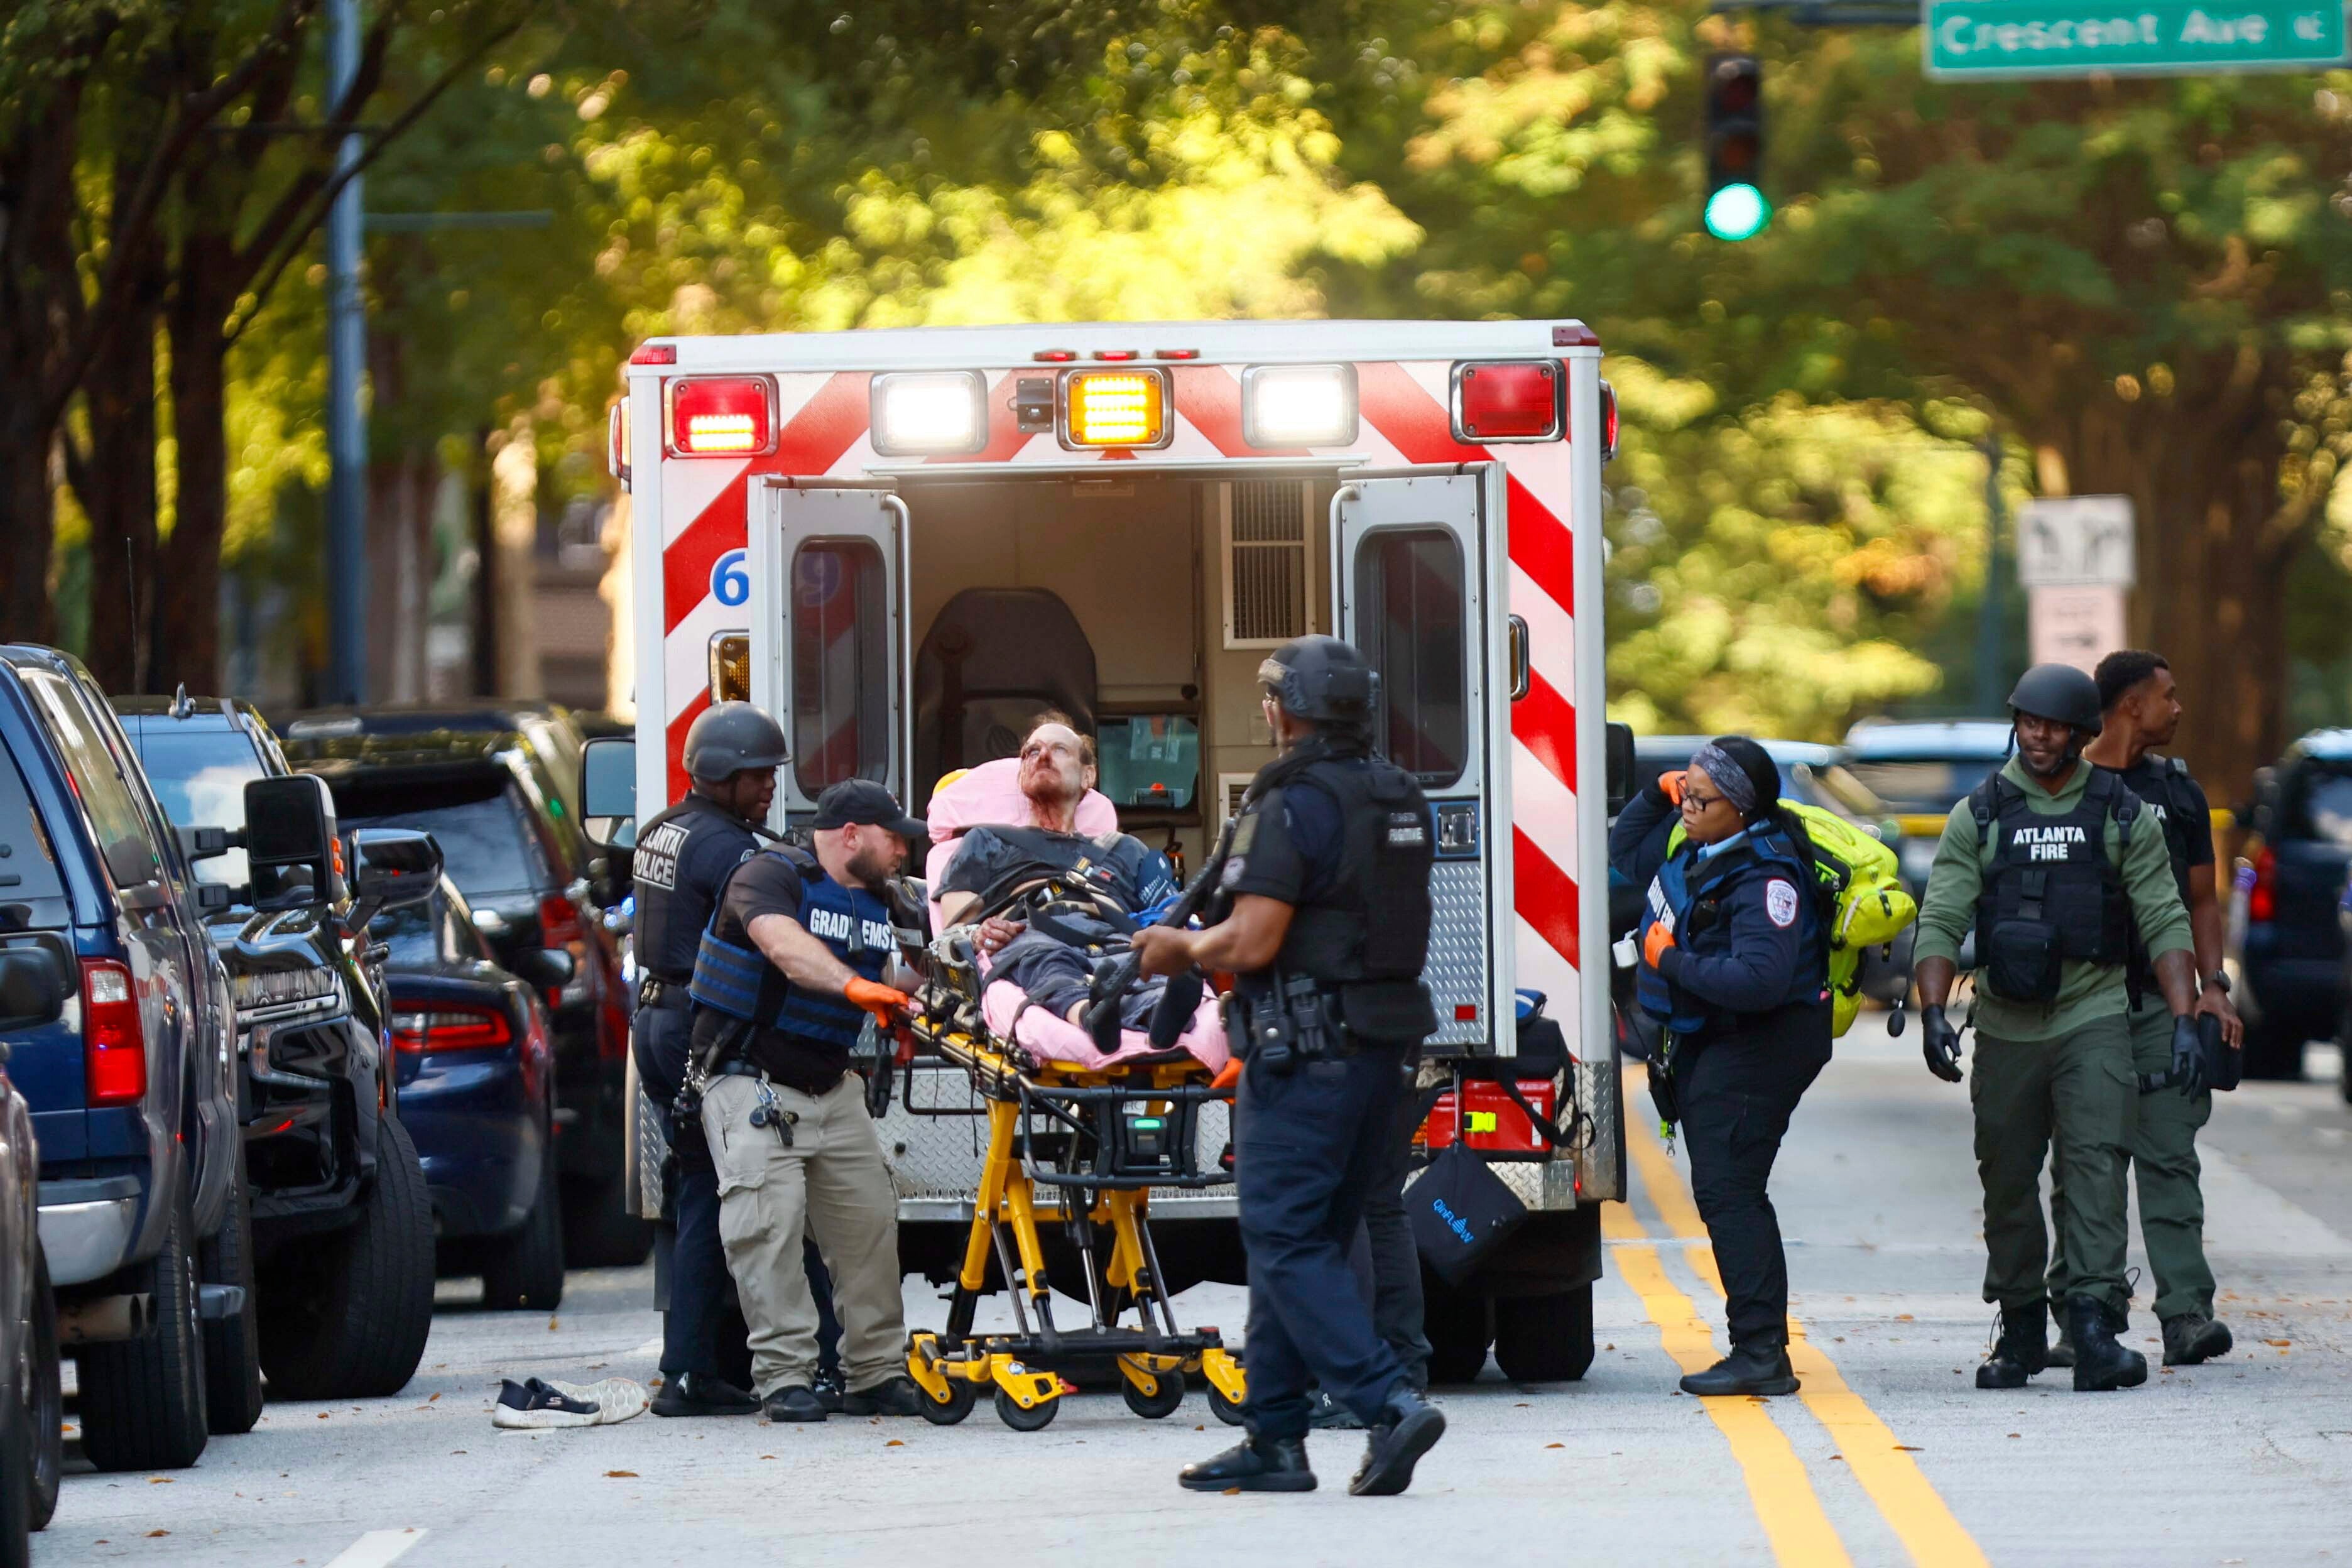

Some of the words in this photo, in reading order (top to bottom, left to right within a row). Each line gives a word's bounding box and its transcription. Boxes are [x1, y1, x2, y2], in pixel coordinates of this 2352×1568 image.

[1939, 15, 2159, 55] Crescent
[2179, 9, 2269, 44] Ave
[640, 825, 682, 857] LANTA
[2013, 826, 2086, 845] ATLANTA
[633, 848, 674, 886] POLICE
[2030, 844, 2069, 862] FIRE
[862, 919, 891, 950] EMS
